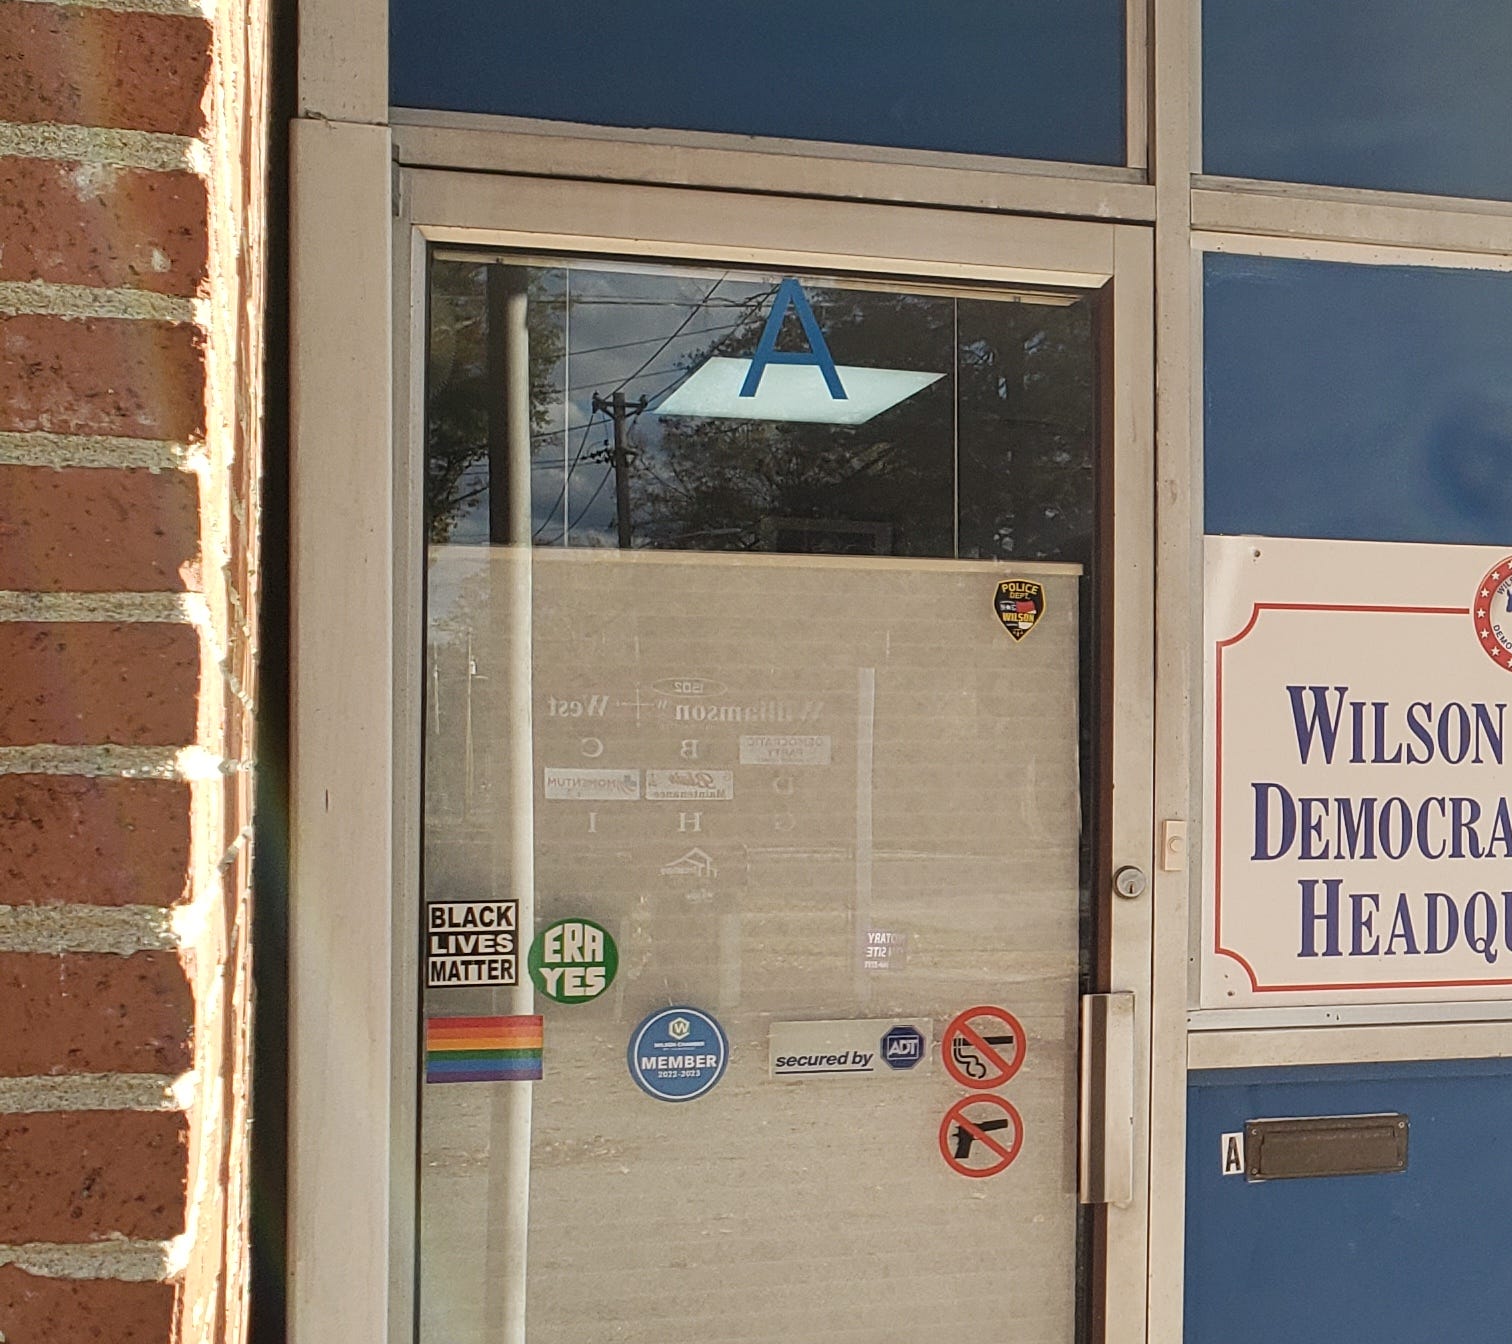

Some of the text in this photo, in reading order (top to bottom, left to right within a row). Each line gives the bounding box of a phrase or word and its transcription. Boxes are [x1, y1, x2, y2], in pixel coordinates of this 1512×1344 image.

[739, 277, 848, 399] A
[1001, 583, 1039, 595] POLICE
[1002, 612, 1035, 622] WILSON
[1286, 685, 1507, 765] WILSON
[431, 905, 513, 928] BLACK
[431, 933, 514, 954] LIVES
[544, 922, 604, 963] ERA
[431, 958, 514, 982] MATTER
[538, 966, 606, 997] YES
[888, 1039, 918, 1056] ADT
[641, 1055, 717, 1069] MEMBER
[775, 1051, 874, 1067] secured by
[658, 1070, 701, 1078] 2022-2023
[1225, 1136, 1242, 1172] A
